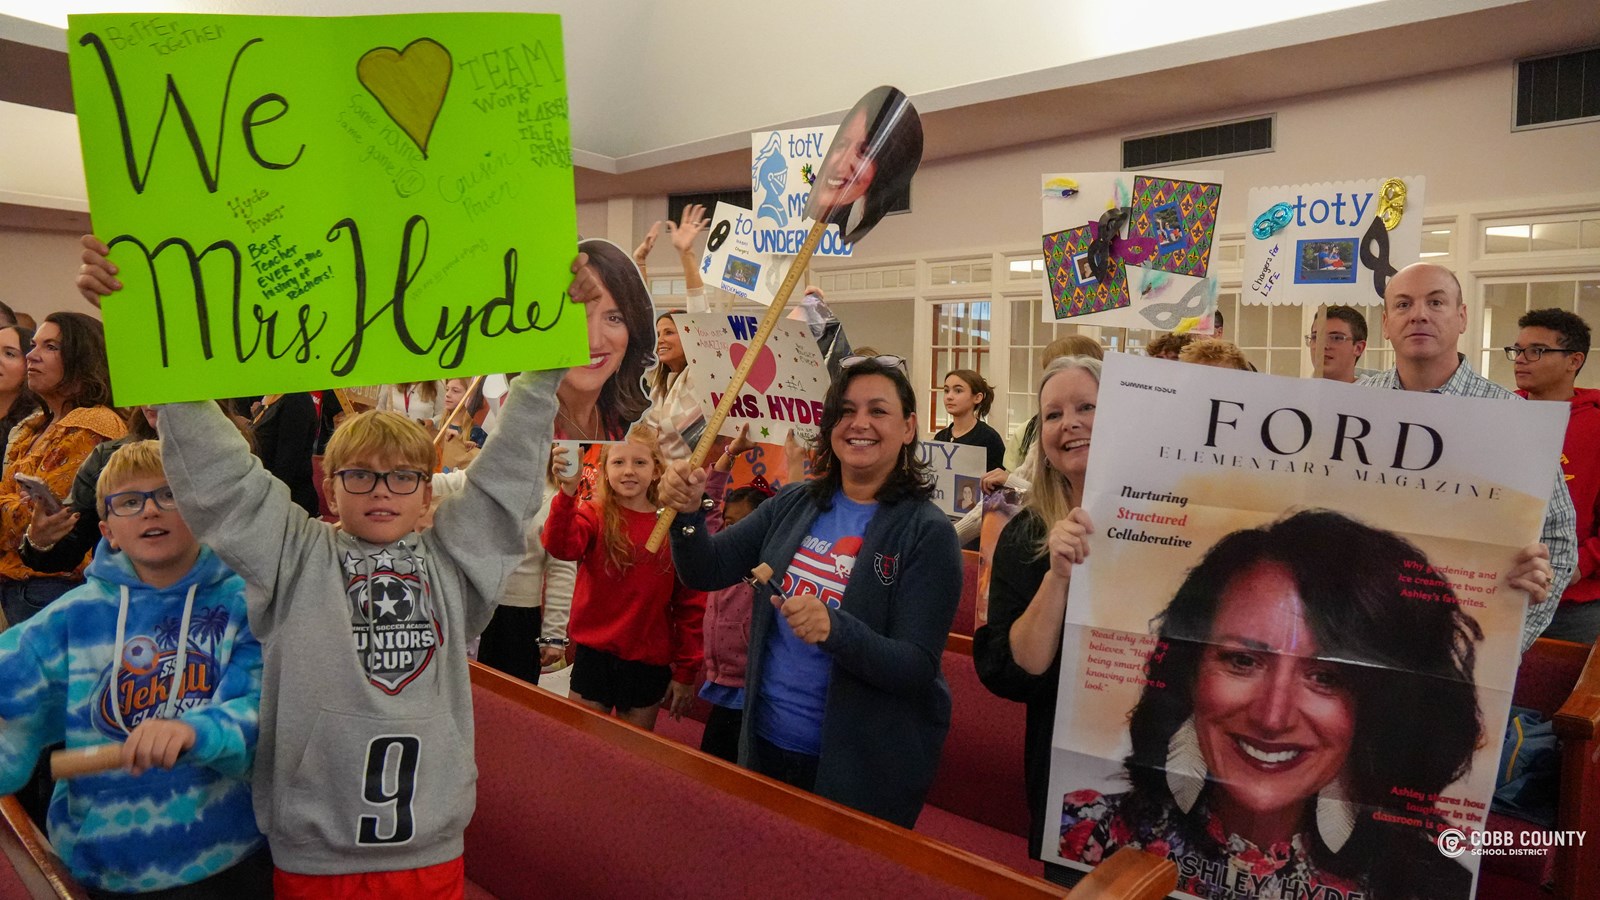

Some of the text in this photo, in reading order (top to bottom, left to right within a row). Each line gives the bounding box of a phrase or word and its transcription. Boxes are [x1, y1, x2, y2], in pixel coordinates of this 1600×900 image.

[458, 39, 562, 91] TEAM
[79, 32, 305, 194] We
[227, 188, 270, 219] Hyde
[1292, 192, 1374, 228] toty
[247, 234, 281, 260] Best
[753, 229, 853, 256] UNDEROOD
[251, 245, 297, 274] Teacher
[257, 264, 292, 288] EVER
[1260, 272, 1281, 297] LIFE
[107, 214, 567, 377] Mrs. Hyde
[727, 315, 759, 340] WE
[766, 394, 824, 426] HYDE
[1204, 398, 1444, 471] FORD
[1159, 446, 1503, 501] ELEMENTARY MAGAZINE
[1121, 485, 1188, 508] Nurturing
[1117, 507, 1188, 527] Structured
[1107, 527, 1192, 548] Collaborative
[1403, 560, 1497, 580] Why gardening and
[1415, 577, 1445, 587] cream
[1446, 580, 1462, 590] are
[1465, 584, 1483, 593] two
[1486, 586, 1498, 595] of
[1400, 588, 1487, 609] Ashley's favorites.
[353, 631, 435, 650] UNIORS
[1091, 629, 1115, 641] Read
[1117, 633, 1136, 646] why
[367, 651, 413, 670] CUP
[1088, 654, 1112, 669] being
[1114, 661, 1141, 671] smart
[1154, 651, 1167, 663] of
[1086, 668, 1125, 684] knowing
[1156, 679, 1167, 689] to
[356, 734, 422, 847] 9
[1390, 786, 1486, 810] Ashley shares how
[1372, 811, 1423, 827] classroom
[1425, 819, 1434, 829] is
[1405, 802, 1483, 823] laughter in the
[1166, 852, 1268, 897] ASHLEY
